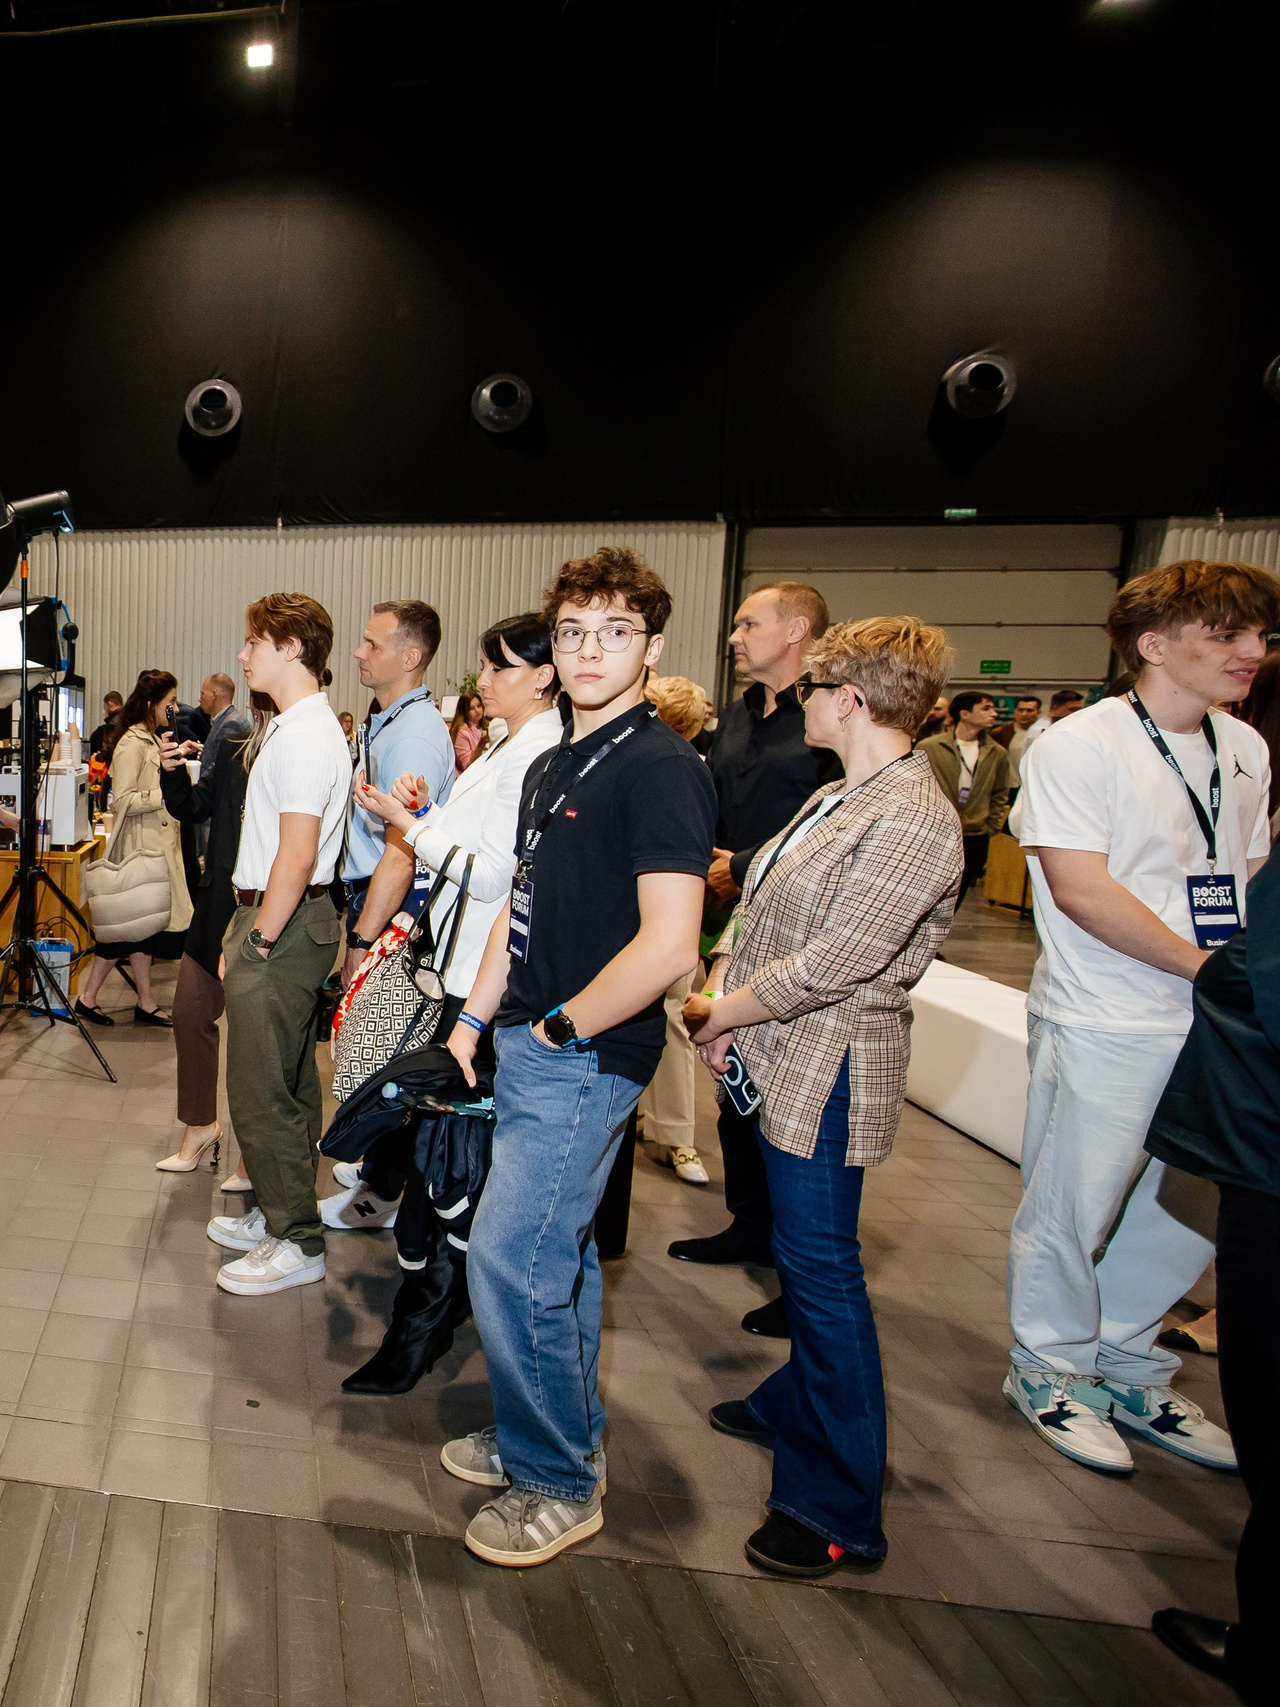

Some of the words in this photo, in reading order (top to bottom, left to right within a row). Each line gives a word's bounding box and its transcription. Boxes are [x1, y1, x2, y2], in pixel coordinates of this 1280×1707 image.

[612, 726, 635, 745] boost
[1142, 718, 1159, 738] boost
[578, 757, 599, 778] boost
[548, 793, 567, 814] boost
[1210, 787, 1220, 808] boost
[527, 830, 543, 851] boost
[513, 888, 531, 906] BOOST
[1192, 886, 1232, 897] BOOST
[512, 899, 530, 917] FORUM
[1193, 896, 1233, 907] FORUM
